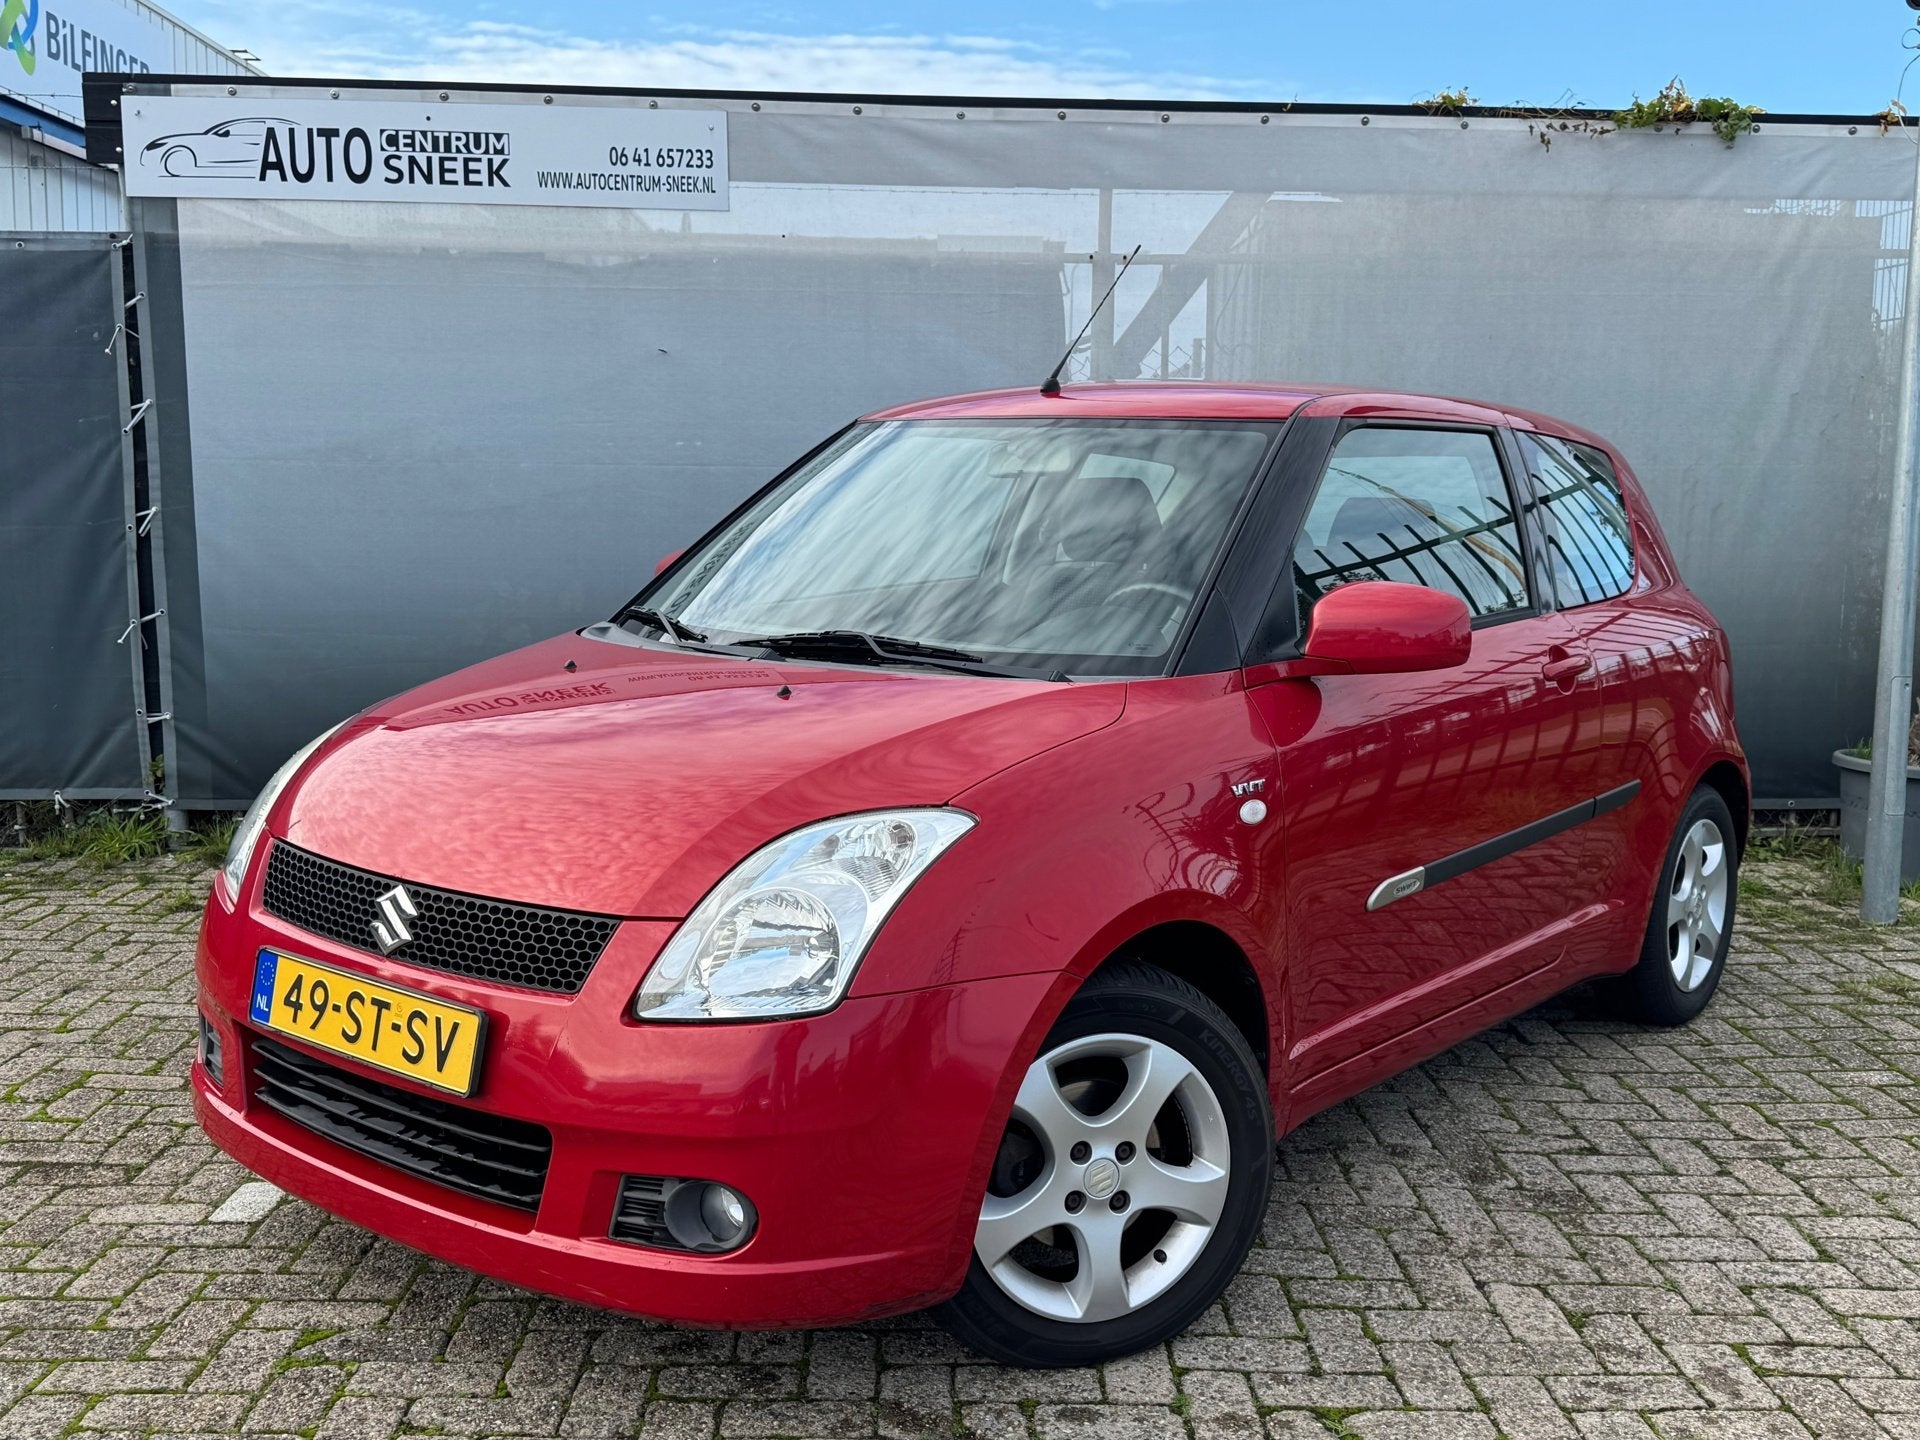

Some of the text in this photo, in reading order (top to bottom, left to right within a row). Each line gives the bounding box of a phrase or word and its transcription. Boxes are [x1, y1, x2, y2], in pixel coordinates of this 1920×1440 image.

[380, 130, 510, 155] CENTRUM
[259, 127, 373, 184] AUTO
[609, 147, 714, 168] 06 41 657233
[384, 155, 511, 187] SNEEK
[537, 170, 716, 194] WWW.AUTOCENTRUM-SNEEK.NL
[256, 993, 269, 1011] NL
[283, 974, 460, 1073] 49-ST-SV
